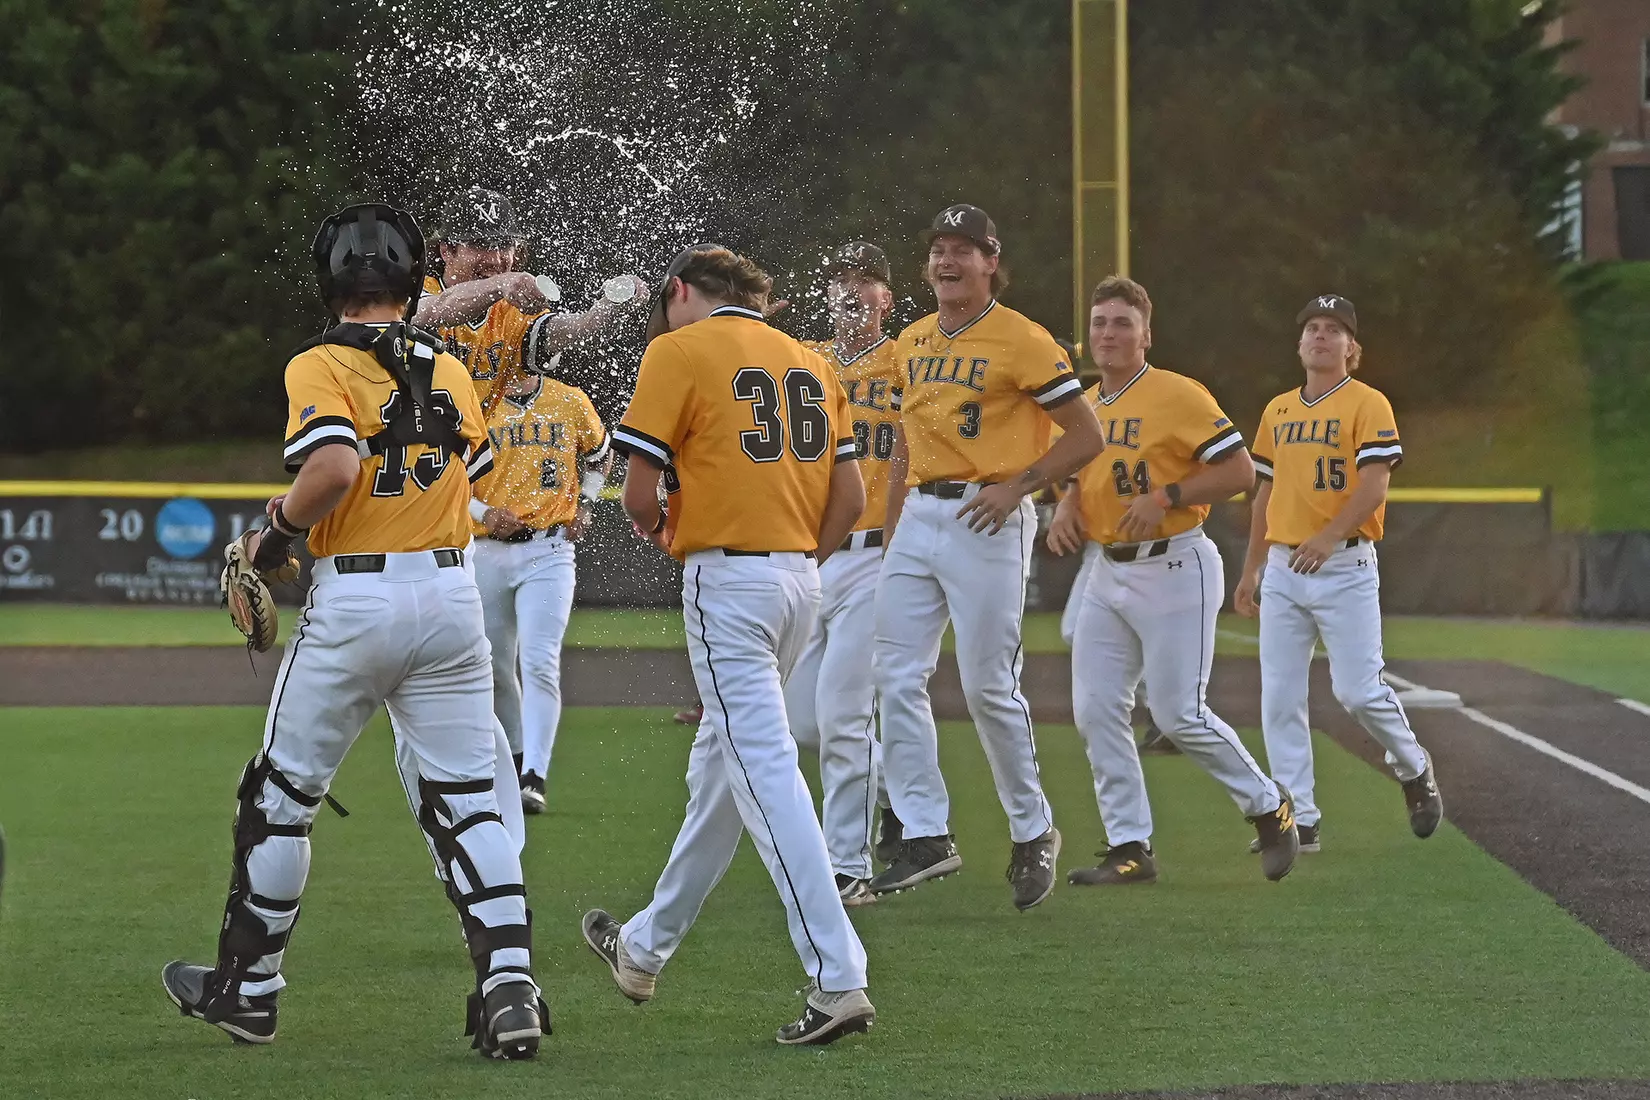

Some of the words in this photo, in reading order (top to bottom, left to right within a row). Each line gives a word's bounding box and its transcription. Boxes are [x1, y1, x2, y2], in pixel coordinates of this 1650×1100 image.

[943, 210, 966, 227] M
[1318, 296, 1337, 309] M
[908, 356, 990, 394] VILLE
[731, 367, 830, 463] 36
[957, 400, 983, 440] 3
[853, 420, 897, 461] 30
[1273, 419, 1341, 450] VILLE
[1111, 458, 1150, 497] 24
[1313, 456, 1347, 493] 15
[97, 508, 145, 542] 20
